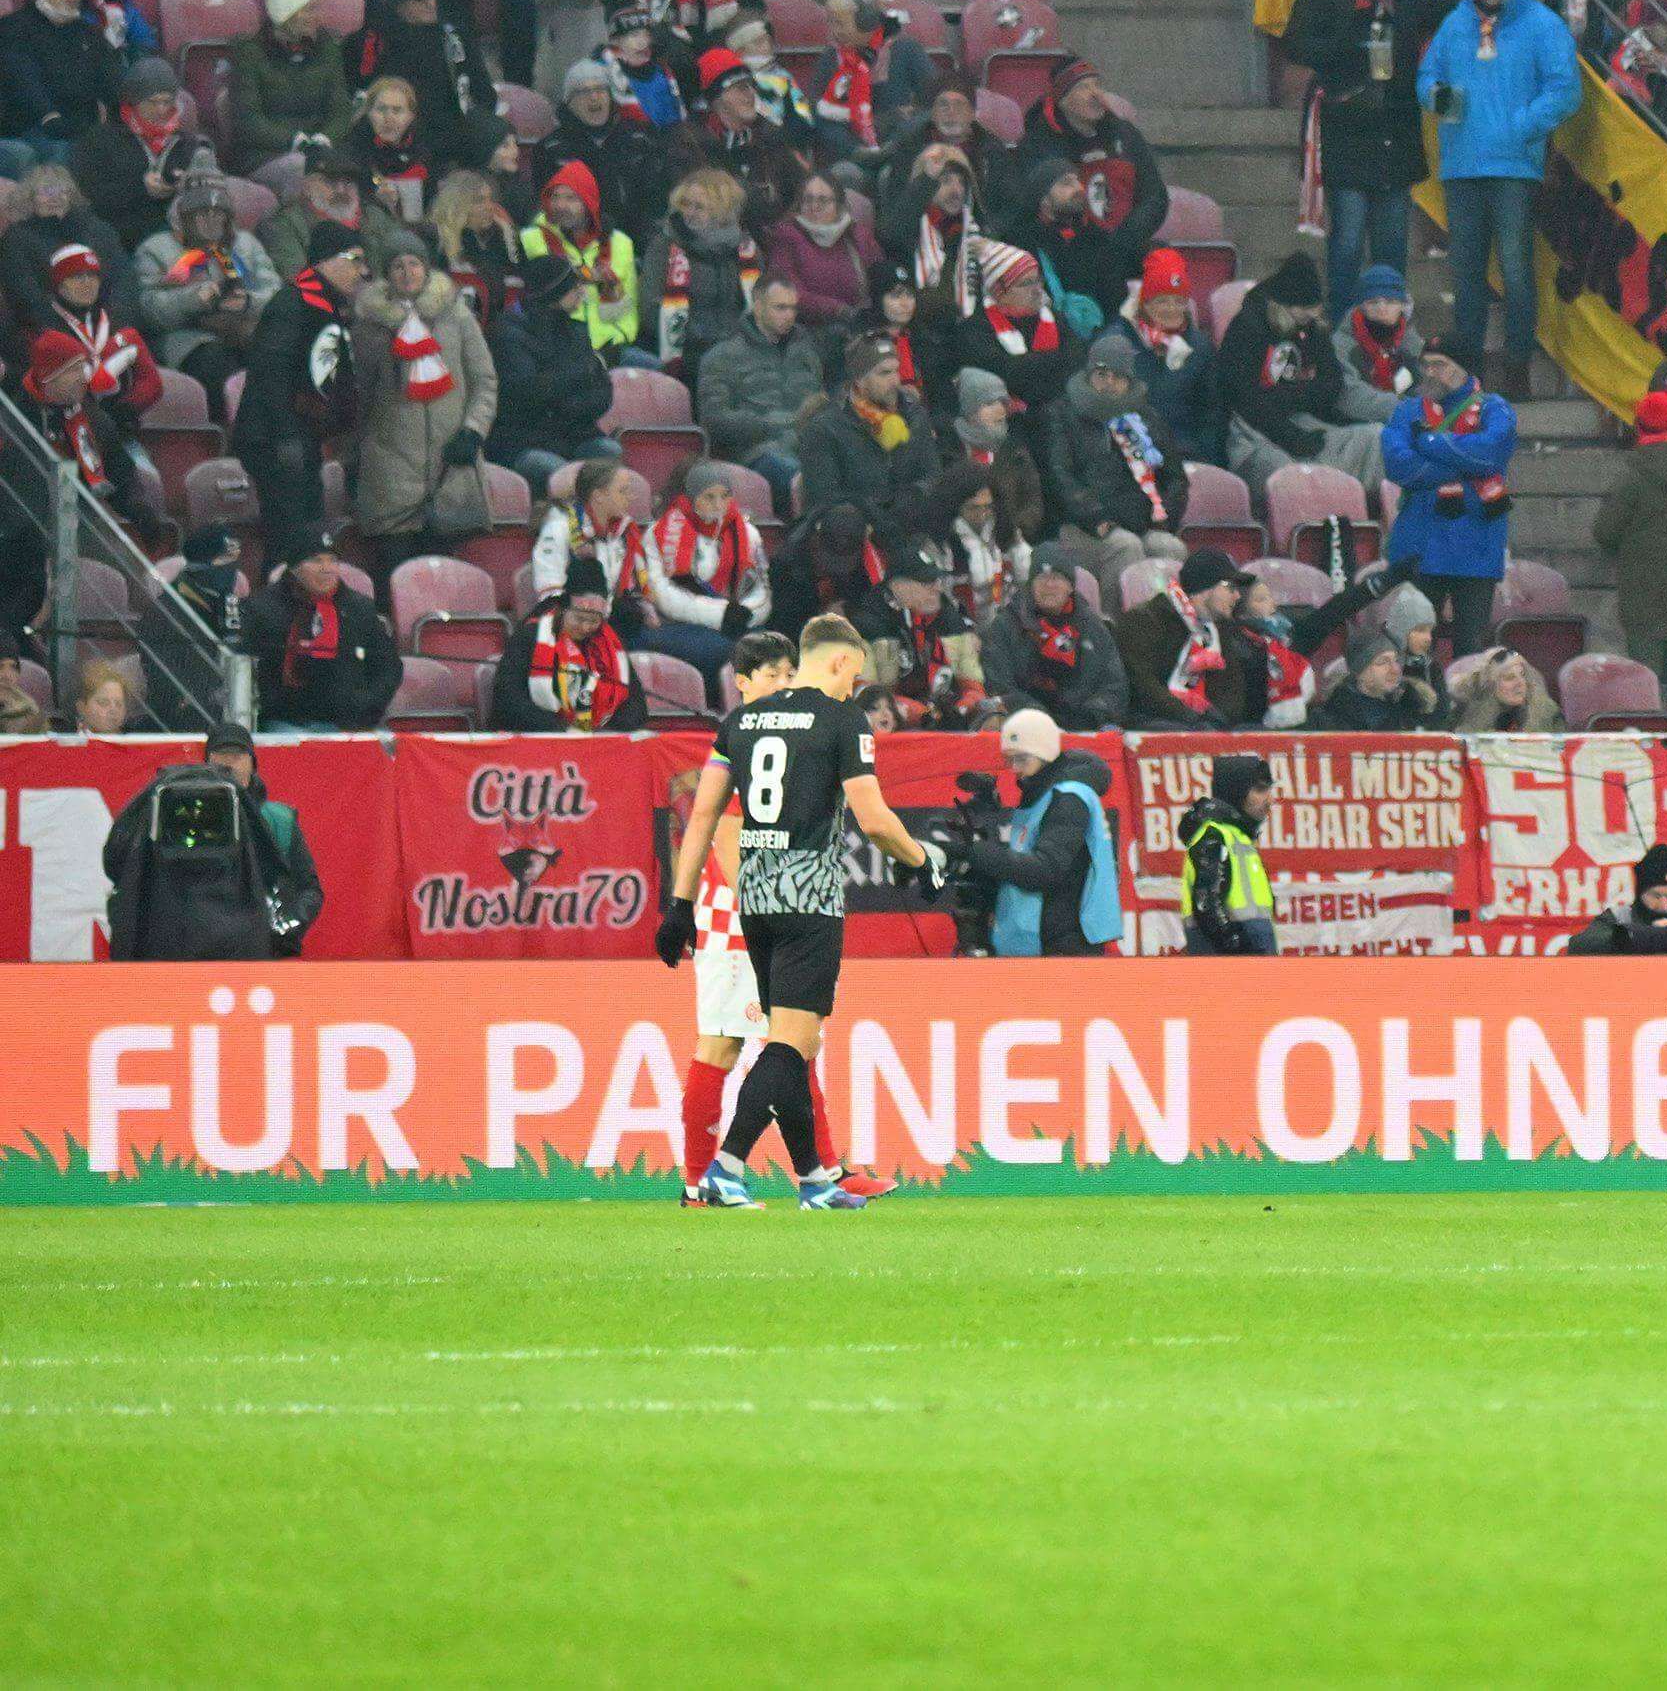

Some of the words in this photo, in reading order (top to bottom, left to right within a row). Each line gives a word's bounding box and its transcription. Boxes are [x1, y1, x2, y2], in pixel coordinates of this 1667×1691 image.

[739, 713, 758, 730] SC
[468, 760, 598, 825] Città
[747, 736, 788, 824] 8
[1138, 745, 1344, 804] FUSALL
[1351, 749, 1465, 800] MUSS
[414, 868, 649, 935] Nostra79
[88, 986, 420, 1173] FÜR
[486, 1019, 1190, 1169] PANEN
